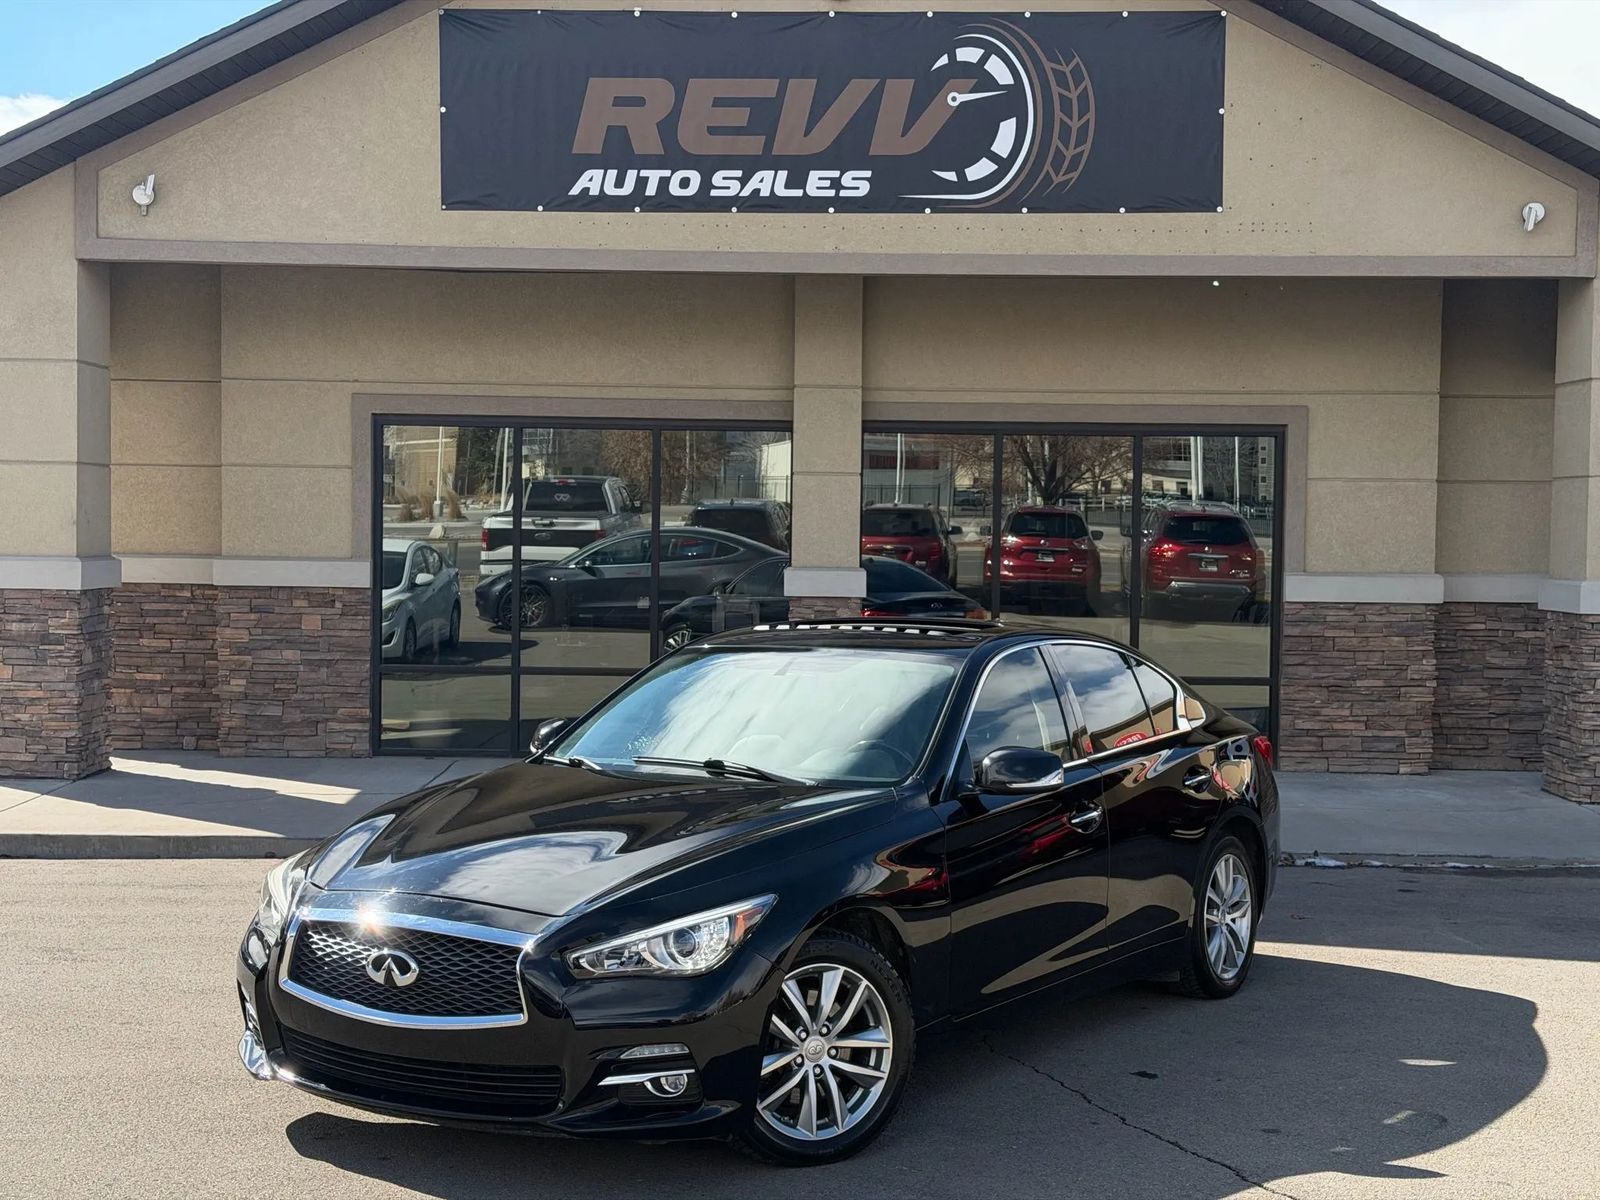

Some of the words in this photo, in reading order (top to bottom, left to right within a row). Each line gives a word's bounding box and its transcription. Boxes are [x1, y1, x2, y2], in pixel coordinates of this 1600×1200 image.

[571, 78, 978, 155] REVV
[568, 169, 701, 196] AUTO
[710, 170, 872, 197] SALES
